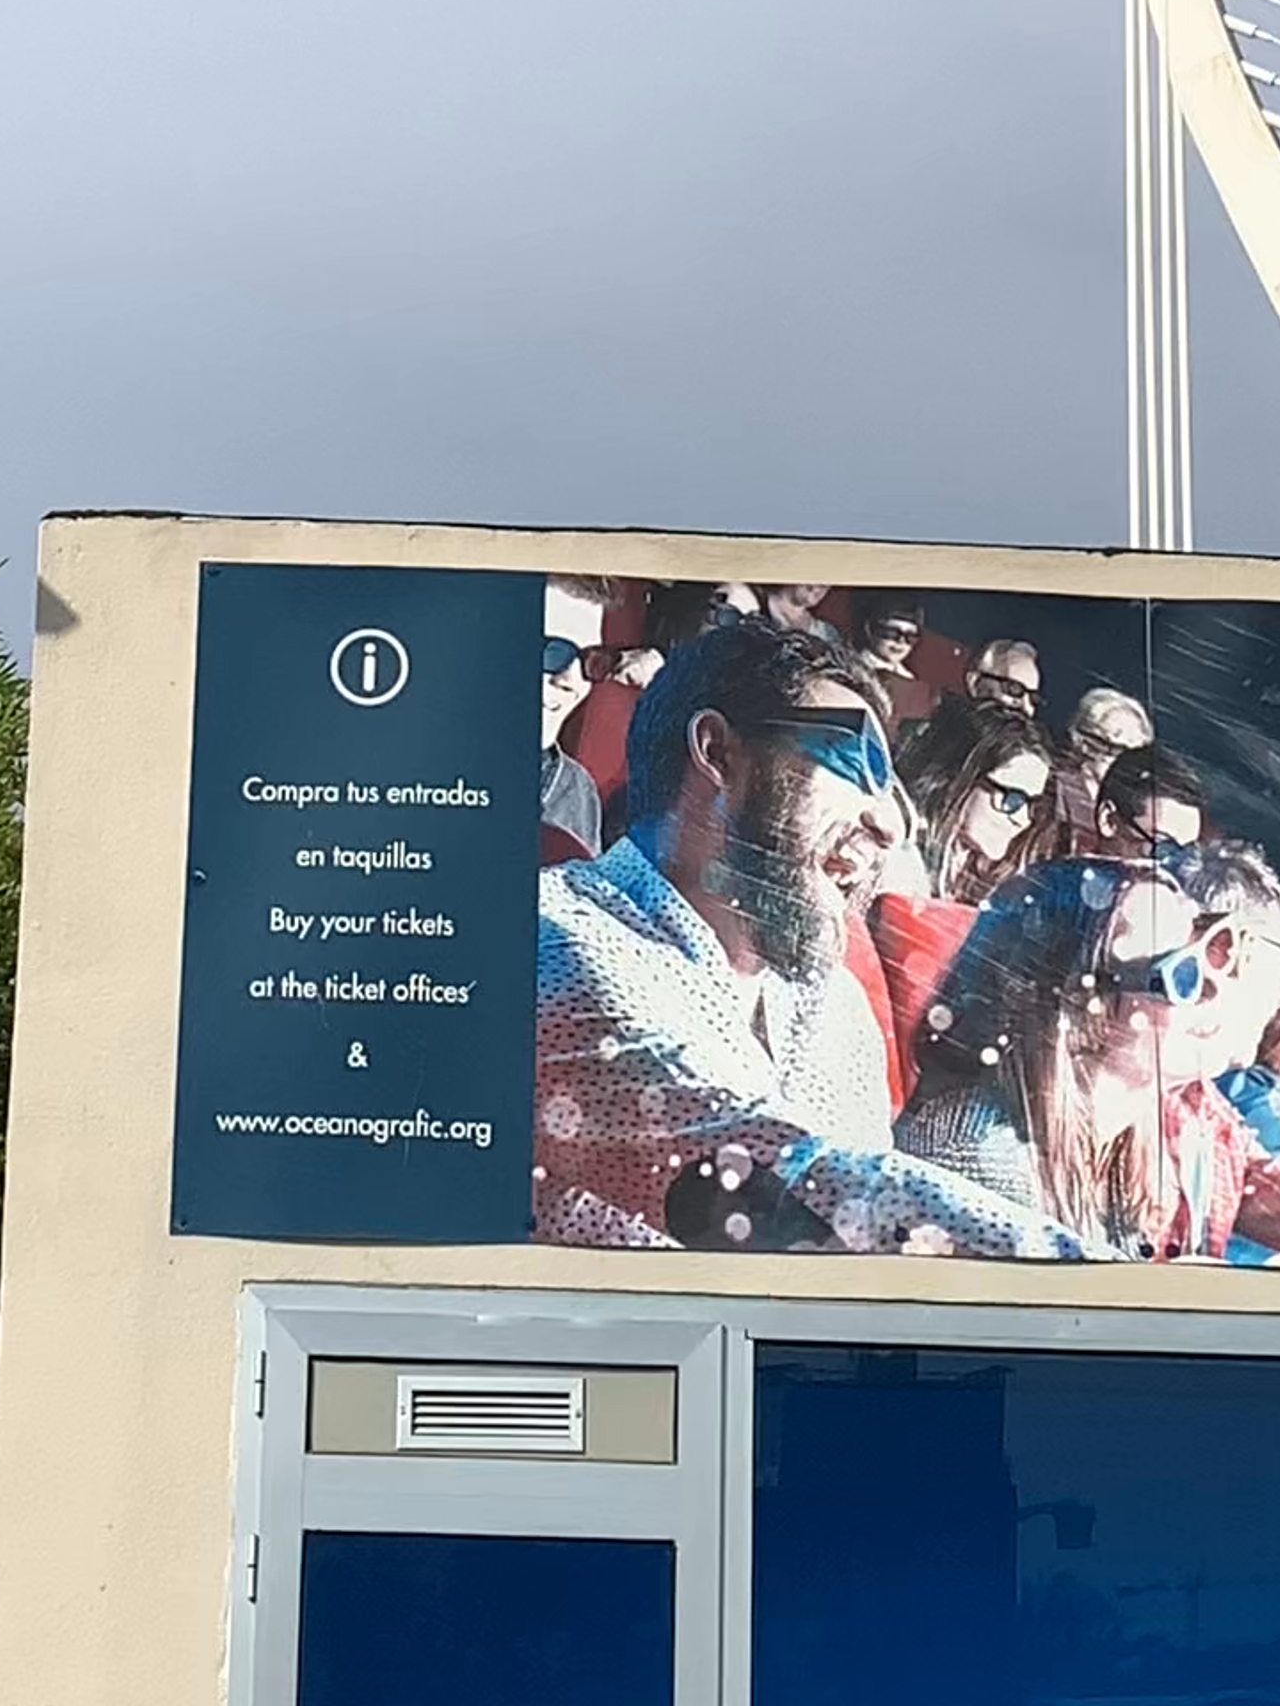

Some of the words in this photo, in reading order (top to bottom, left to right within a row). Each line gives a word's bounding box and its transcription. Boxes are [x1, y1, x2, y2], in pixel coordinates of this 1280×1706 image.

[242, 776, 340, 809] Compra
[347, 781, 380, 804] tus
[386, 778, 491, 806] entradas
[296, 849, 324, 867] en
[333, 841, 433, 875] taquillas
[270, 907, 314, 940] Buy
[320, 913, 376, 940] your
[382, 907, 455, 936] tickets
[249, 975, 274, 999] at
[281, 970, 318, 999] the
[325, 972, 387, 1001] ticket
[393, 973, 470, 1004] offices
[346, 1041, 369, 1068] &
[216, 1108, 492, 1148] www.oceanografic.org
